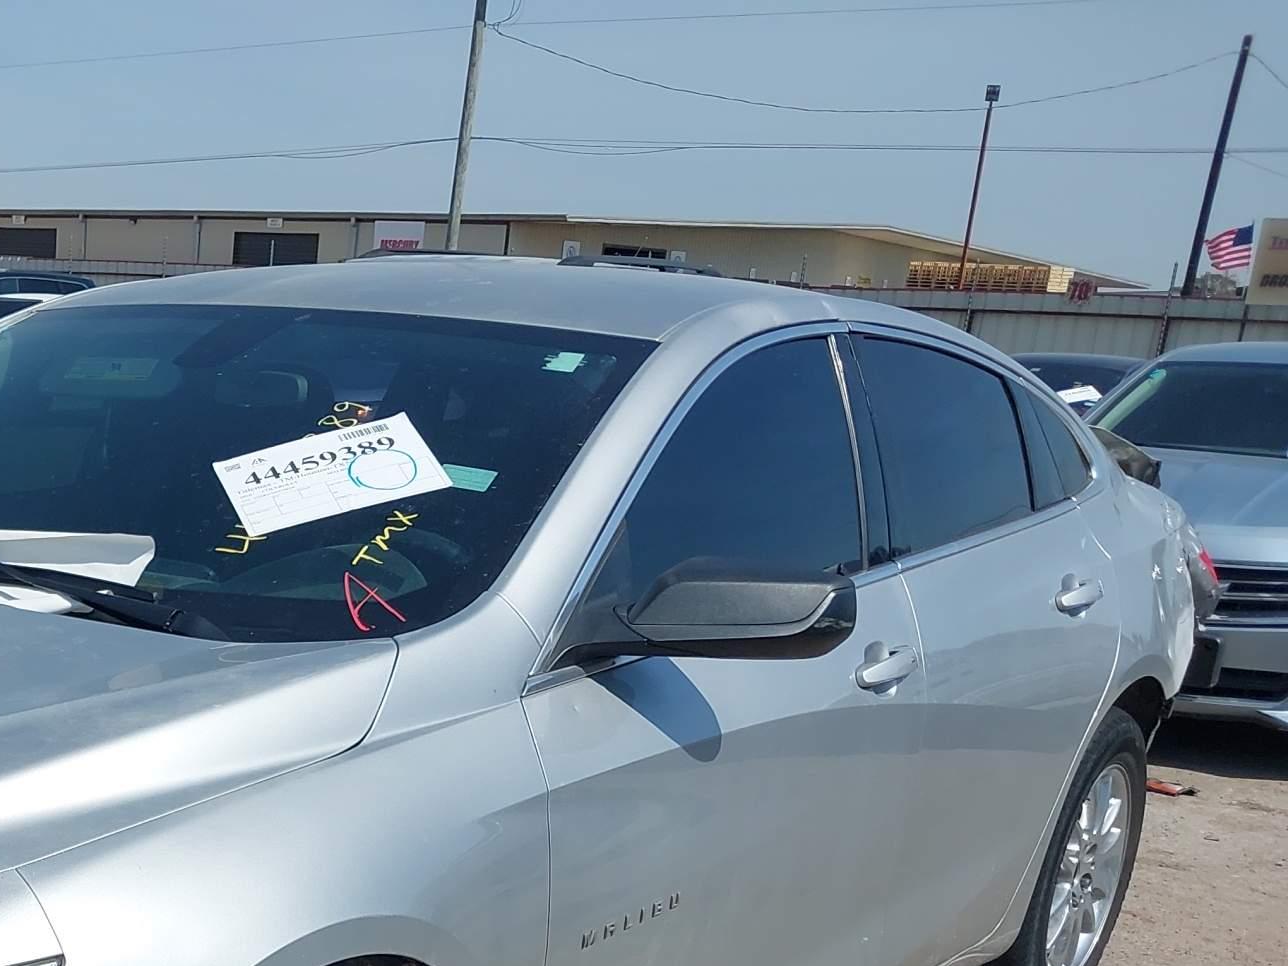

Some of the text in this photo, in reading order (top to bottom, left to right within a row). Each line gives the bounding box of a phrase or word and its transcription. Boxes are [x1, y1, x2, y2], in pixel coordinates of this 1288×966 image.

[244, 436, 396, 486] 44459389
[344, 570, 408, 631] A
[581, 892, 680, 950] MALIBU
